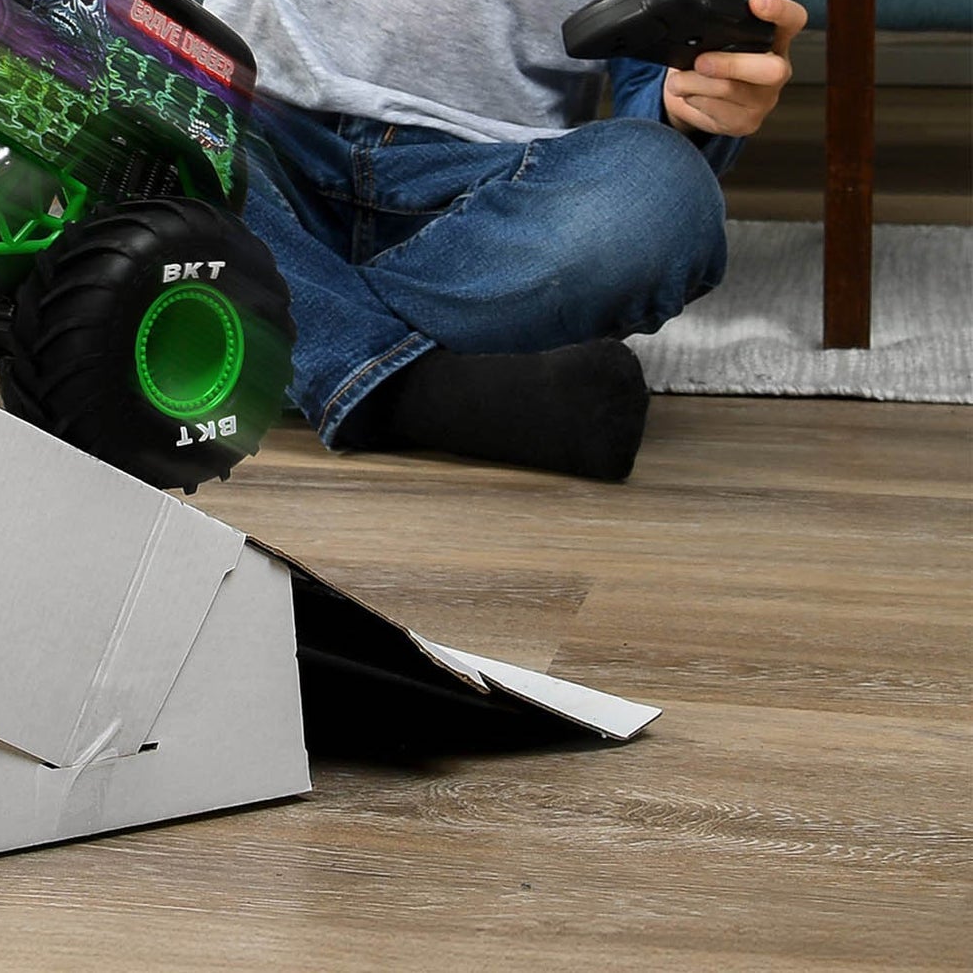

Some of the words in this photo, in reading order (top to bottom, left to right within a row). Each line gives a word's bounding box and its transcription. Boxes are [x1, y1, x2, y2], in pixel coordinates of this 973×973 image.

[181, 28, 235, 84] DIGGER
[162, 261, 226, 283] BKT
[176, 415, 237, 447] BKT
